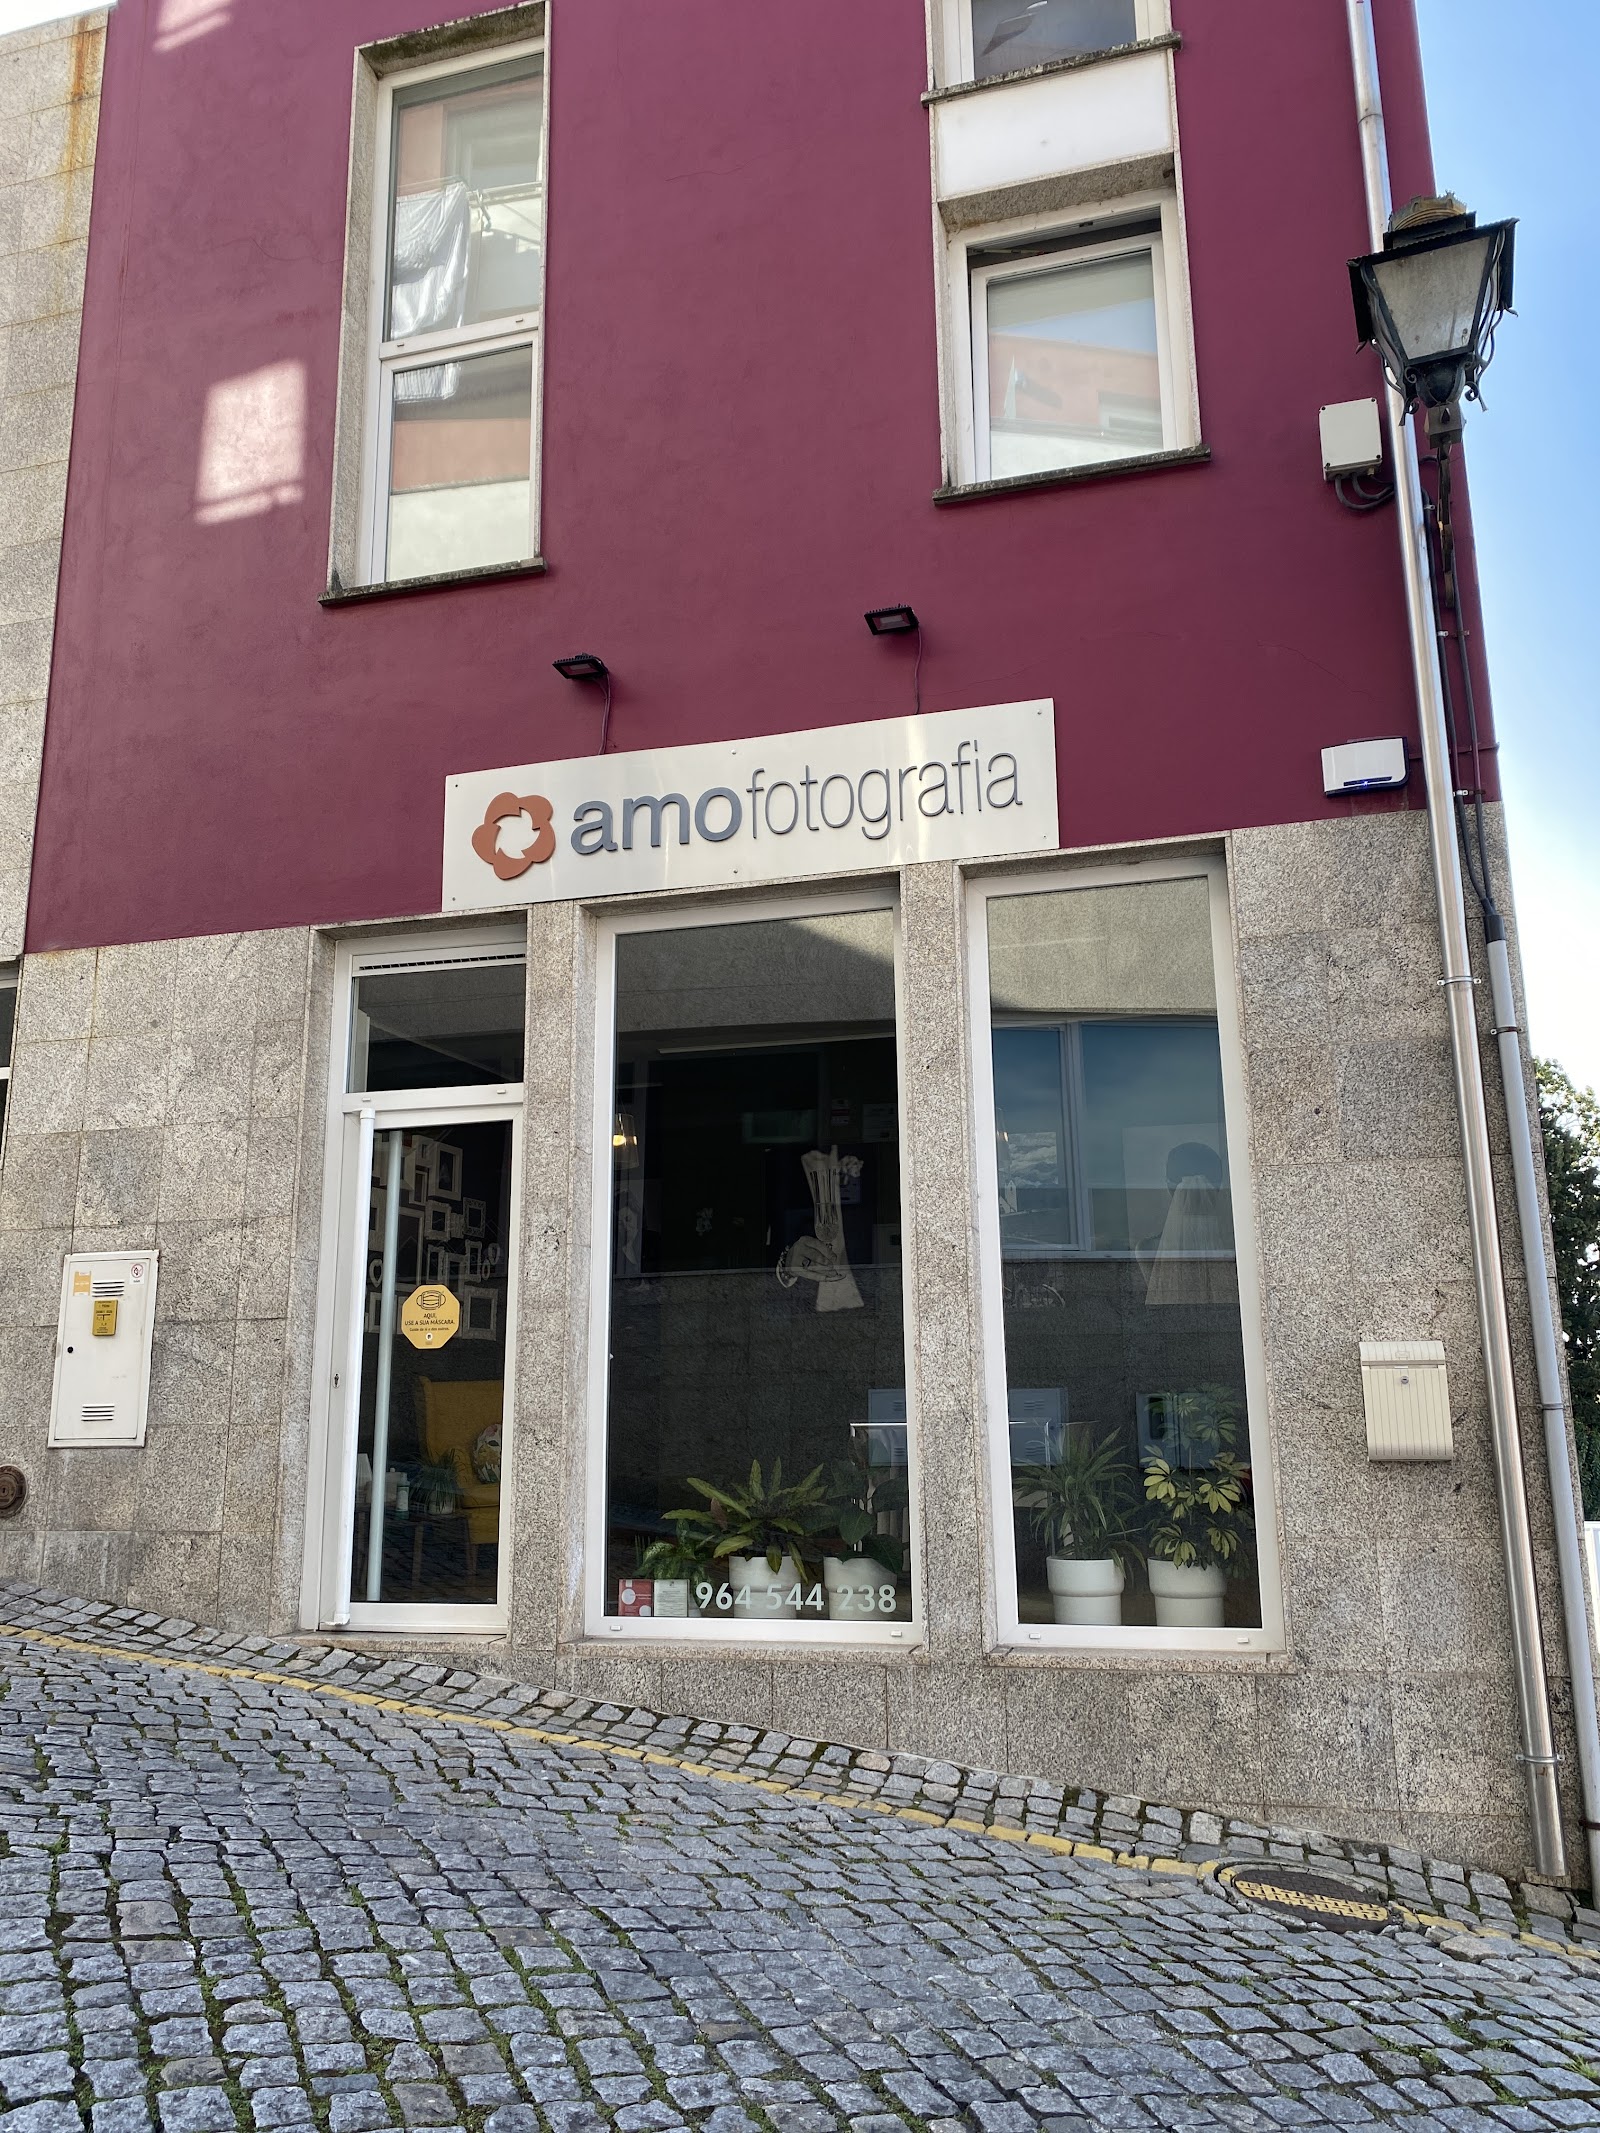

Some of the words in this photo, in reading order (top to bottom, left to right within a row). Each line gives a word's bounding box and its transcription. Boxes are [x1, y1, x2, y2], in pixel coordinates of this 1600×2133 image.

[696, 1581, 752, 1610] 964
[766, 1582, 825, 1611] 544
[836, 1584, 897, 1613] 238
